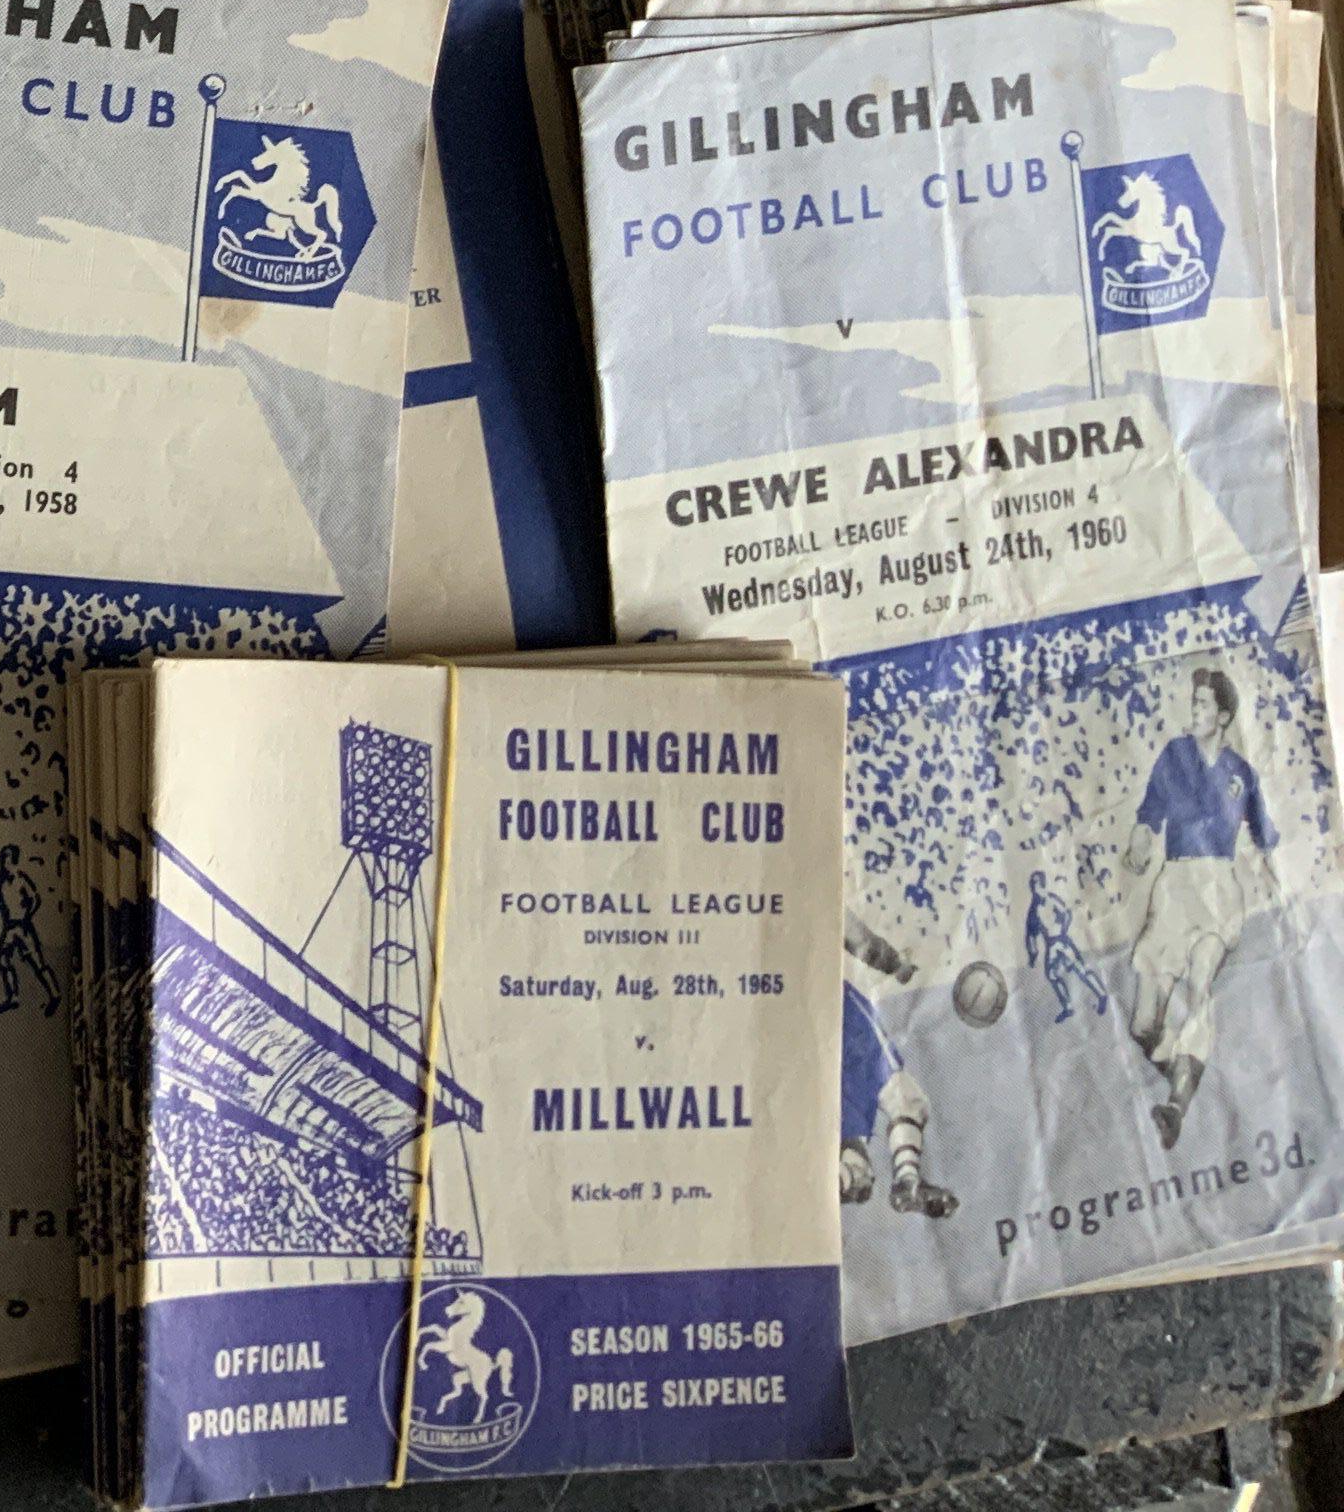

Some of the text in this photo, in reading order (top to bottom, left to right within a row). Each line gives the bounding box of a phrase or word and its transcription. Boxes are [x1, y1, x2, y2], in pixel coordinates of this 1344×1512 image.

[21, 78, 177, 130] CLUB
[614, 73, 1036, 174] GILLINGHAM
[622, 156, 1050, 259] FOOTBALL CLUB
[63, 461, 78, 482] 4
[665, 415, 1144, 528] CREWE ALEXANDRA
[24, 489, 78, 515] 1958
[724, 493, 1075, 568] FOOTBALL LEAGUE DIVISION
[701, 515, 1128, 618] Wednesday, August 24th, 1960
[875, 605, 915, 624] K.O.
[506, 727, 780, 775] GILLINGHAM
[498, 799, 785, 843] FOOTBALL CLUB
[501, 893, 784, 915] FOOTBALL LEAGUE
[584, 929, 668, 945] DIVISION
[499, 974, 784, 1001] Saturday, Aug. 28th, 1965
[532, 1085, 753, 1132] MILLWALL
[571, 1183, 713, 1204] Kick-off p.m.
[994, 1130, 1316, 1258] programme 3d.
[215, 1341, 325, 1378] OFFICIAL
[571, 1320, 785, 1357] SEASON 1965-66
[572, 1375, 786, 1412] PRICE SIXPENCE
[187, 1395, 349, 1442] PROGRAMME
